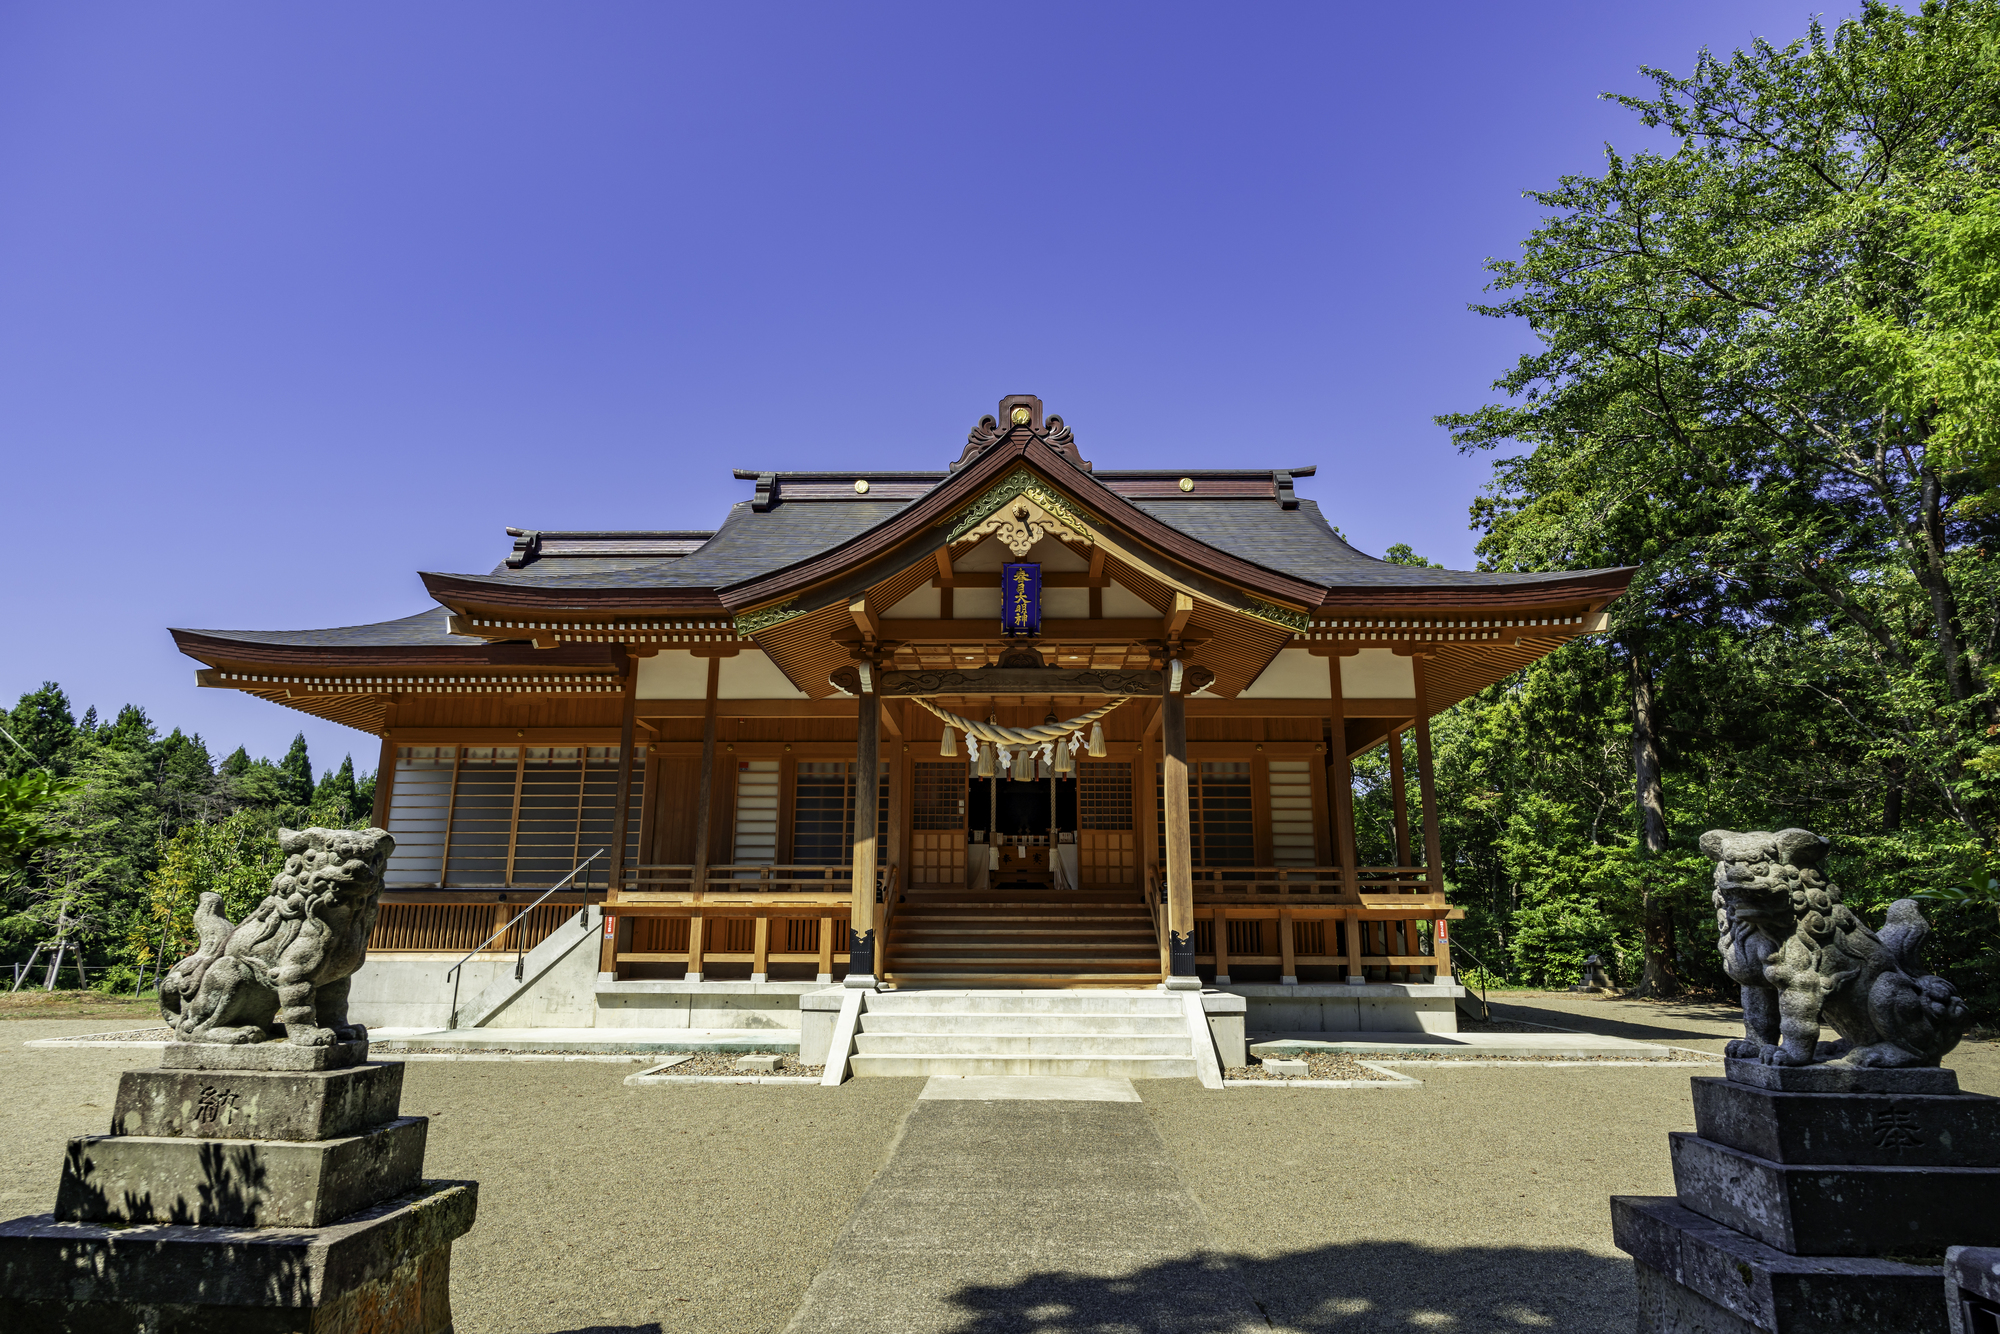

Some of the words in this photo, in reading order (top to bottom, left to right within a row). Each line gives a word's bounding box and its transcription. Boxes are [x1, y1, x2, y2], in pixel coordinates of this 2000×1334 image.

[1013, 567, 1032, 627] 春日大明神
[1873, 1105, 1926, 1156] 奉
